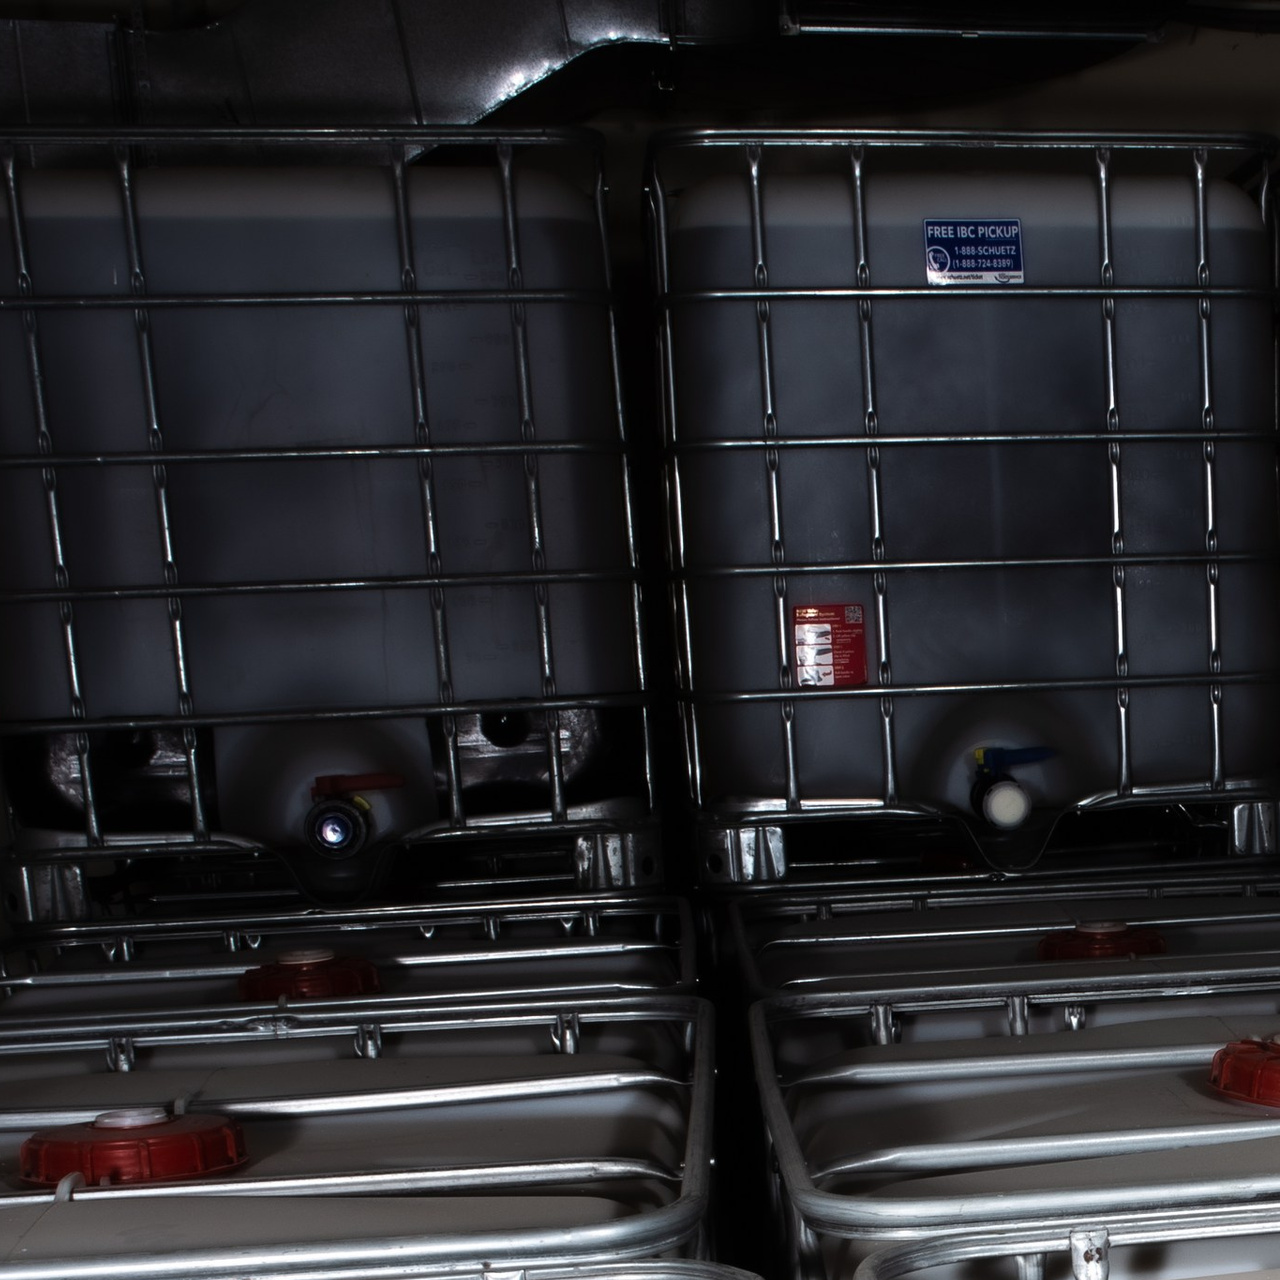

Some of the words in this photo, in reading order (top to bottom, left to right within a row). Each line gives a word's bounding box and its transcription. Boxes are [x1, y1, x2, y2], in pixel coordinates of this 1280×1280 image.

[927, 226, 955, 238] FREE
[957, 226, 976, 238] IBC
[978, 226, 1019, 238] PICKUP
[954, 246, 1016, 255] 1-888-SCHUETZ
